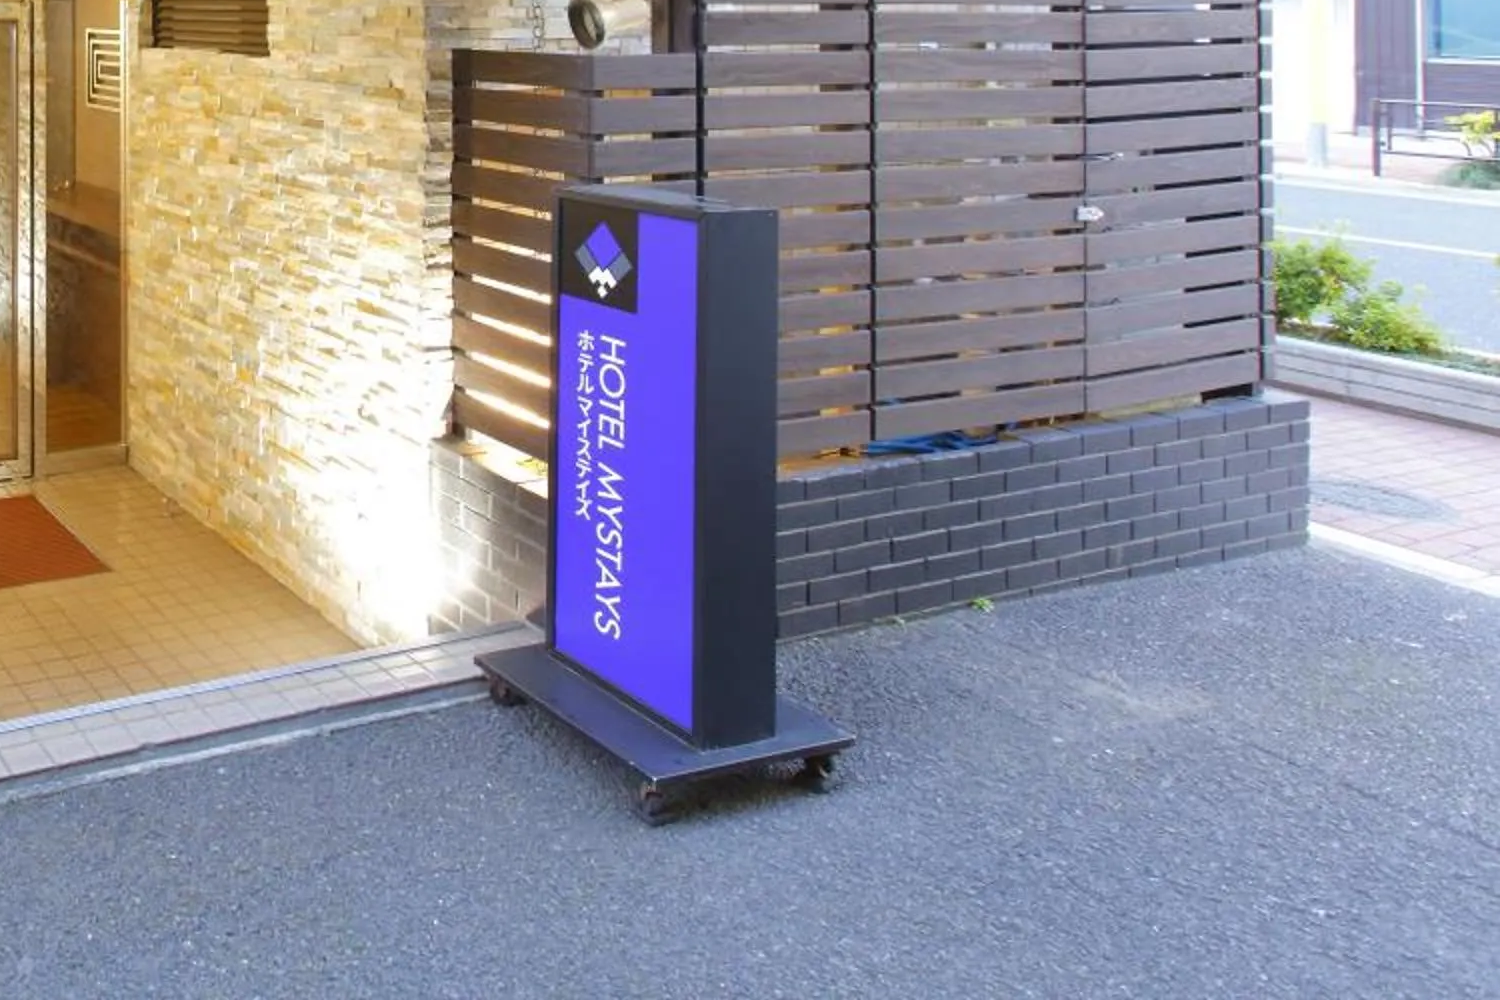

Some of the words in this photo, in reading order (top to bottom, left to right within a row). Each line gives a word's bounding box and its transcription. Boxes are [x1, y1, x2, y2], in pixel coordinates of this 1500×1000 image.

[575, 329, 595, 521] ホテルマイステイズ
[598, 334, 627, 450] HOTEL
[594, 461, 624, 641] MYSTAYS
